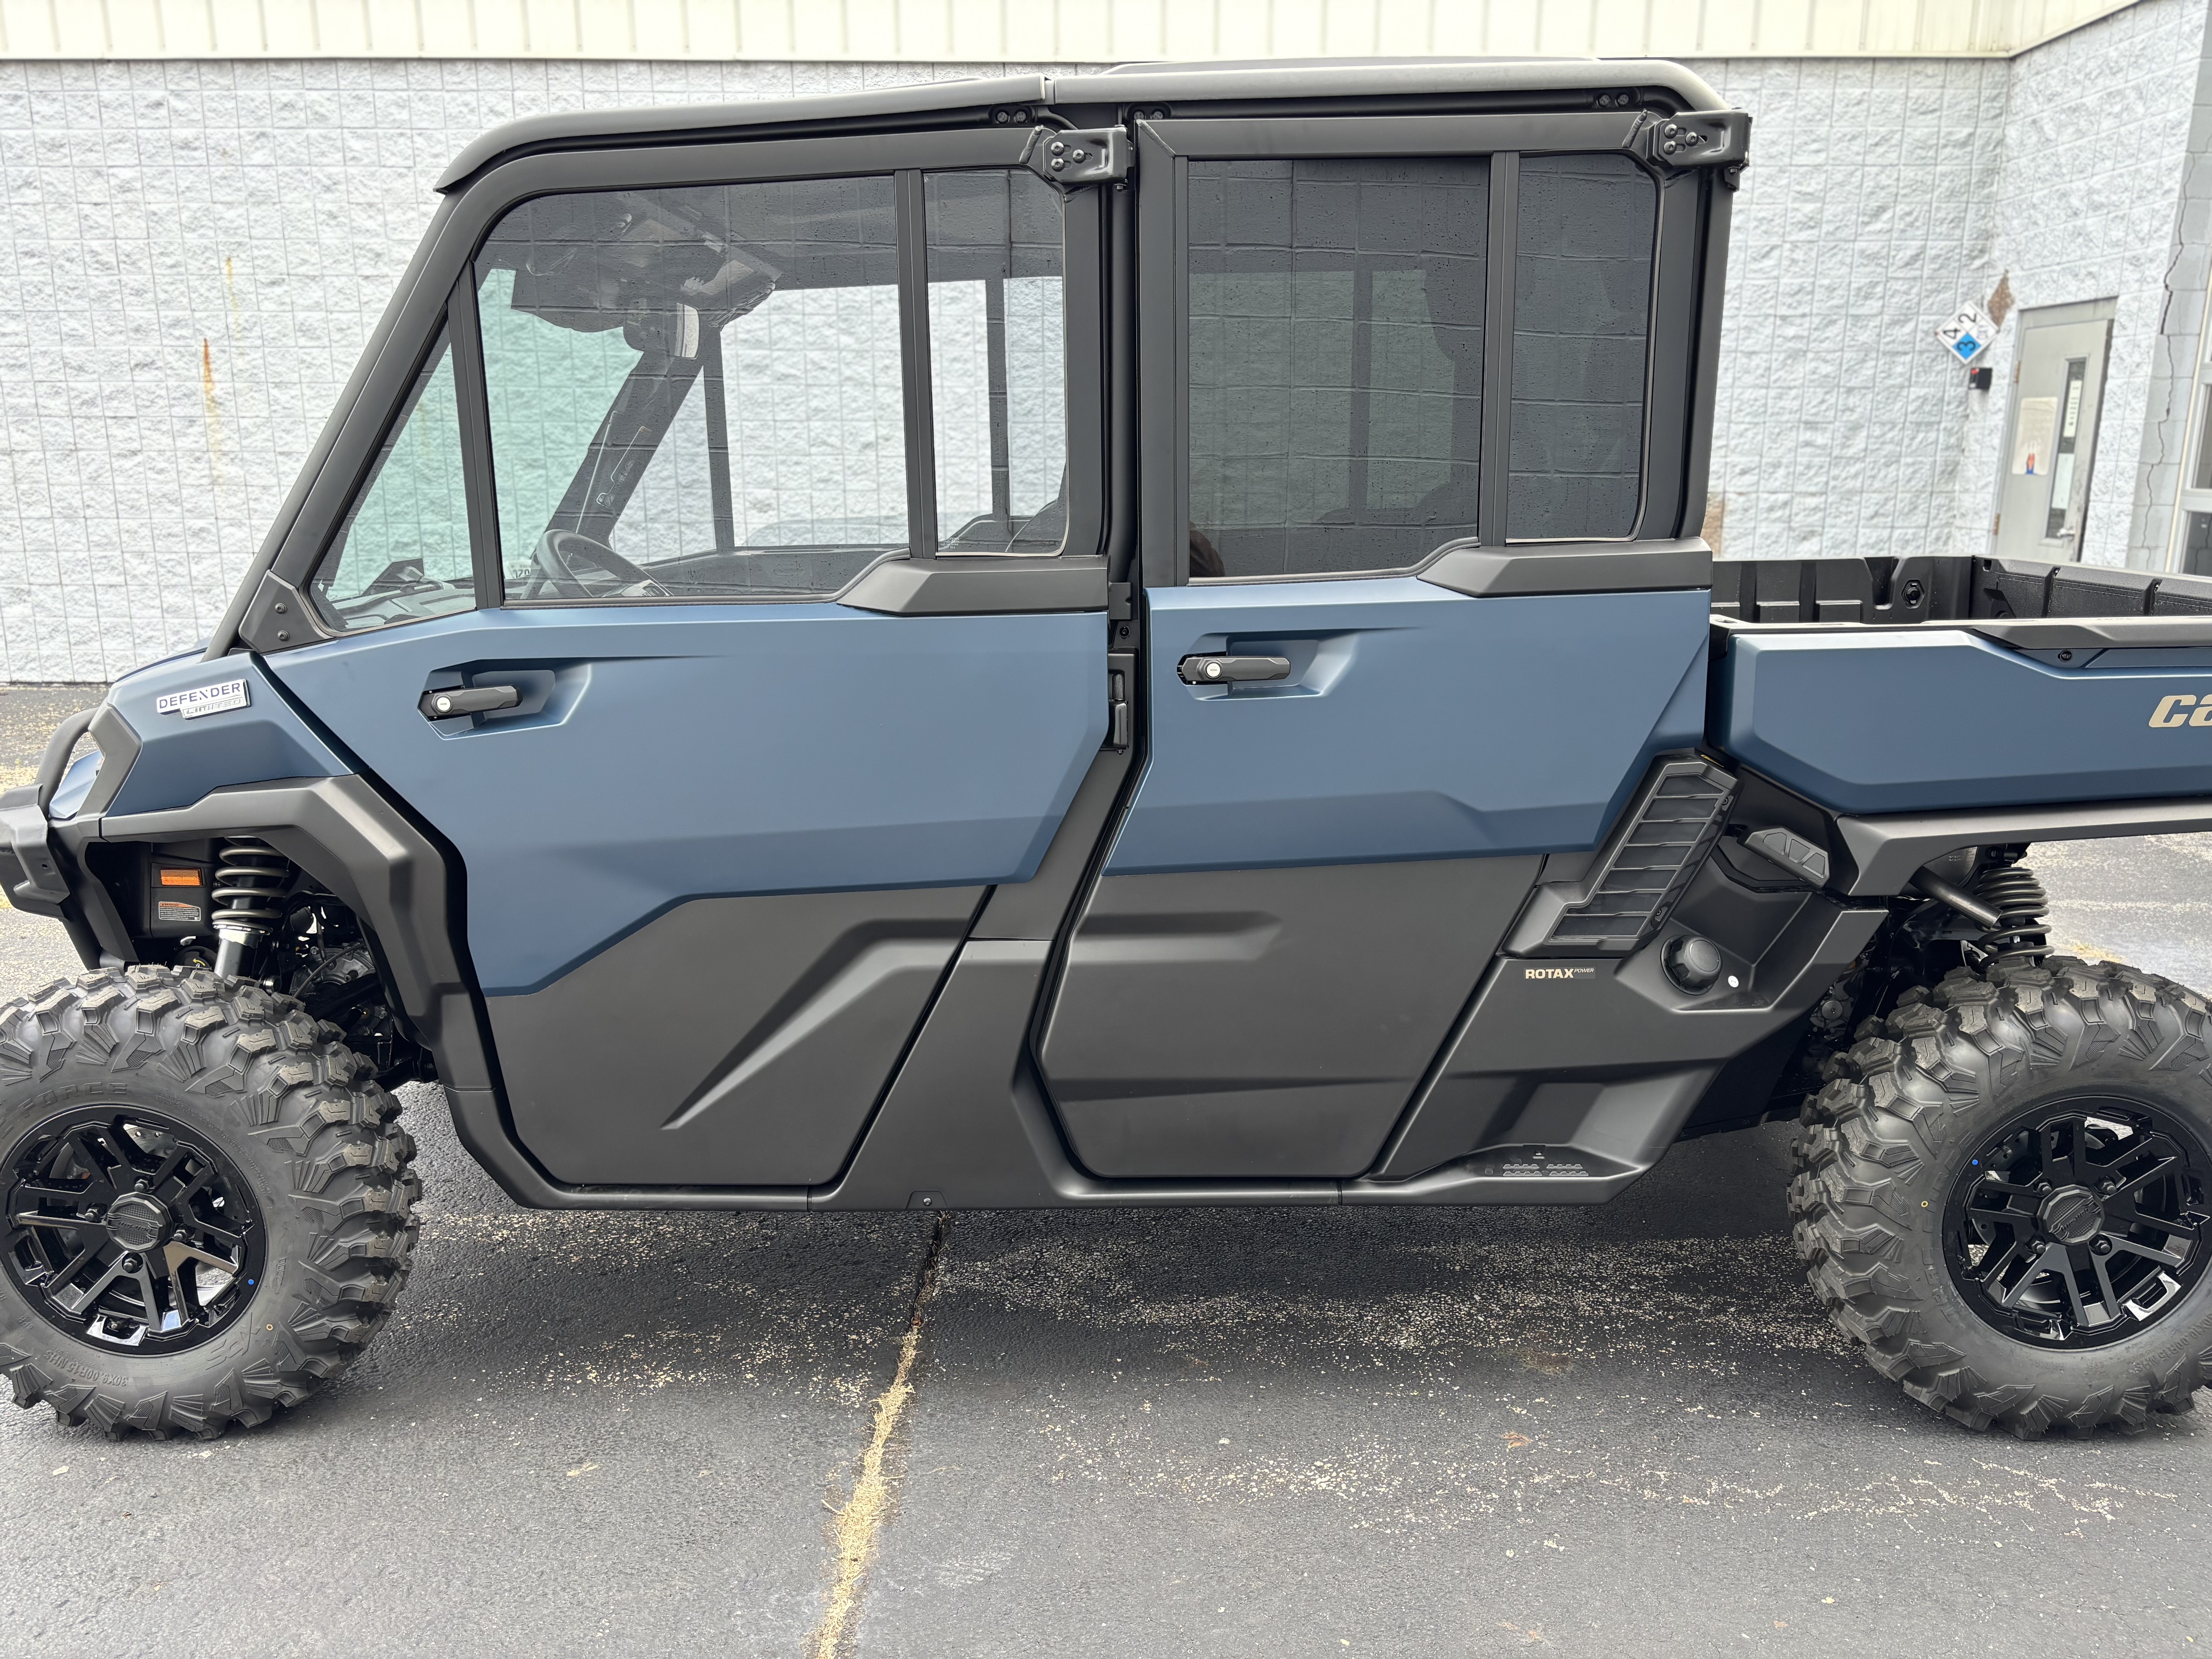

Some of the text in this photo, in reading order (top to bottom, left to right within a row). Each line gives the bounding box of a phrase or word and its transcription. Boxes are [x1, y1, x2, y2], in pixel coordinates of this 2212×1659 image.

[1958, 313, 1977, 323] 2
[1942, 328, 1961, 339] 4
[1957, 341, 1976, 351] 3
[159, 683, 240, 709] DEFENDER
[186, 698, 241, 714] LIMITED
[1525, 969, 1574, 979] ROTAX
[17, 1082, 128, 1118] FORCE
[42, 1350, 69, 1370] NHS
[65, 1363, 129, 1387] 30X9.00R15
